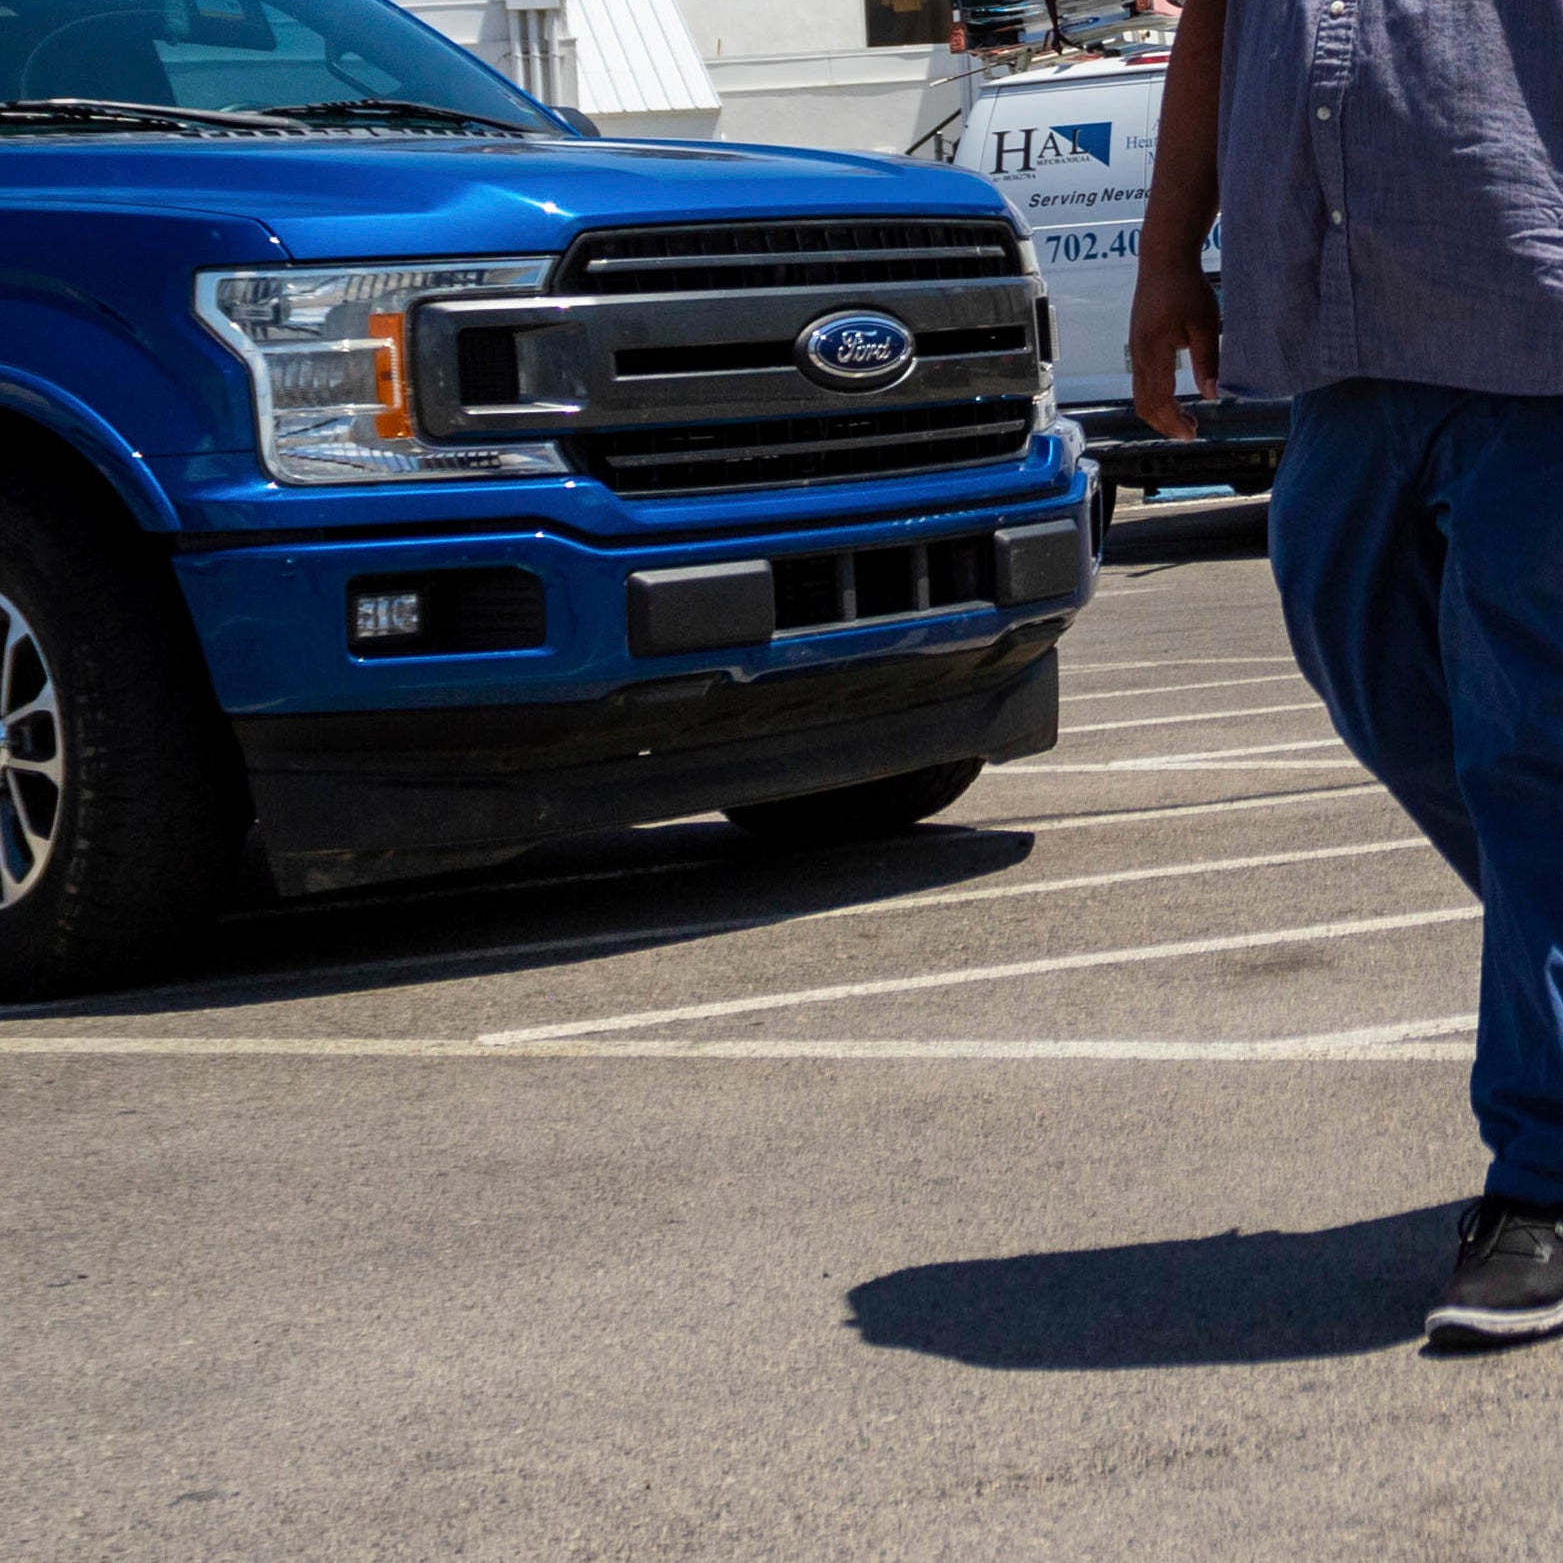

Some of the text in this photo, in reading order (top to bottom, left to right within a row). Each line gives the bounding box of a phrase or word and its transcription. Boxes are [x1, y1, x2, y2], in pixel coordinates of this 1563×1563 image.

[989, 127, 1091, 175] HAL
[1036, 155, 1091, 166] MECHANICAL
[1028, 188, 1150, 208] Serving Neva
[836, 329, 892, 364] Ford
